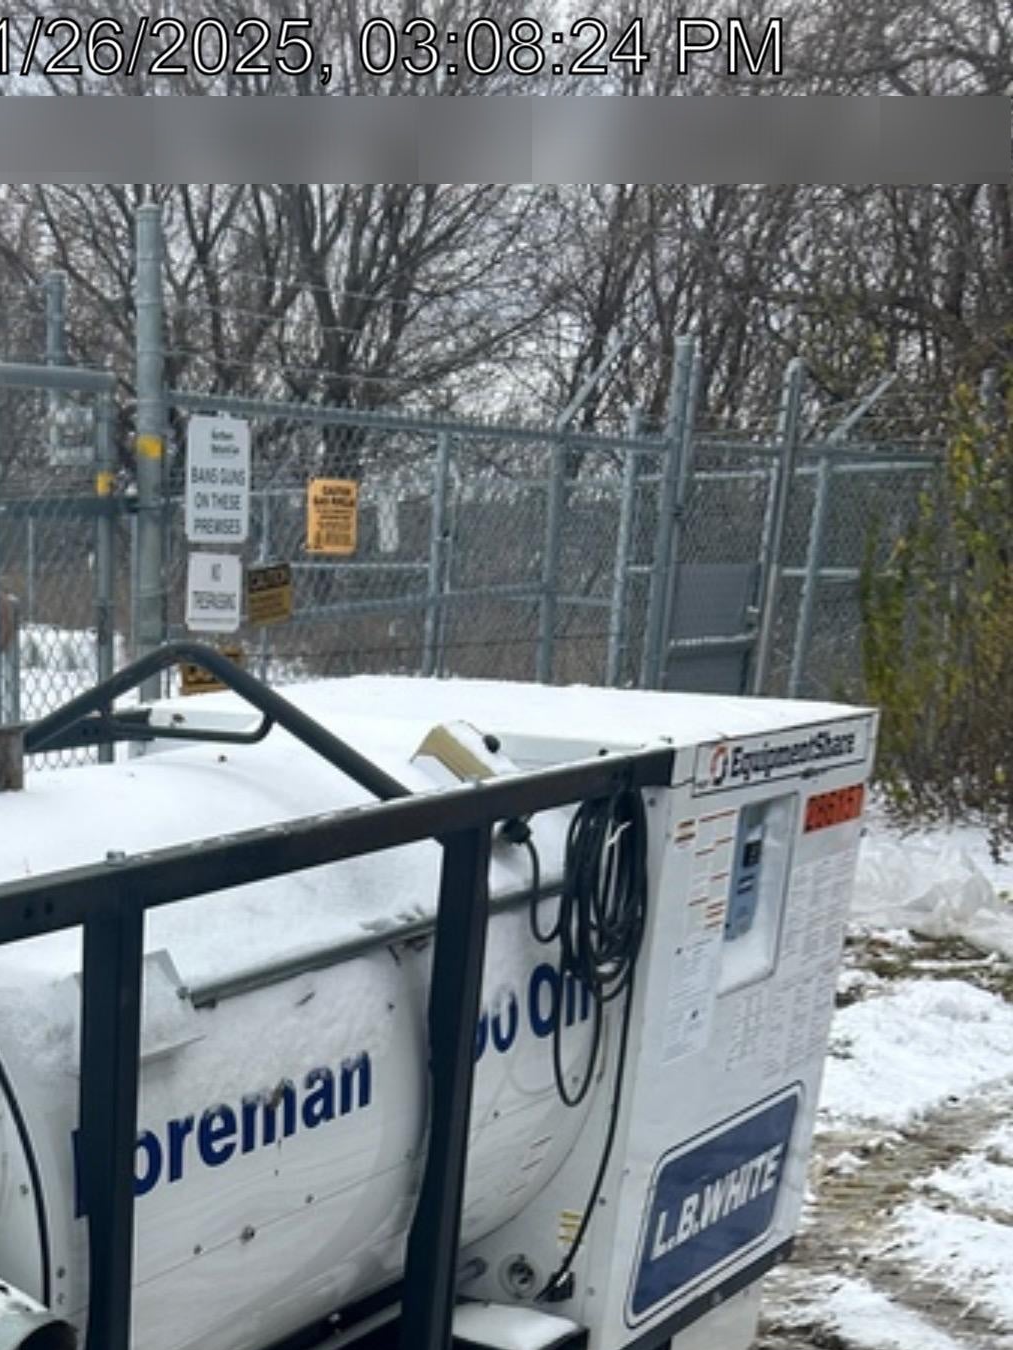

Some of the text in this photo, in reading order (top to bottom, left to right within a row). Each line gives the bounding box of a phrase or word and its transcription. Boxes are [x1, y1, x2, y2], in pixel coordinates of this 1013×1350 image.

[194, 491, 242, 511] ON THESE
[730, 731, 855, 782] EquipmentShare
[72, 1050, 372, 1219] oreman
